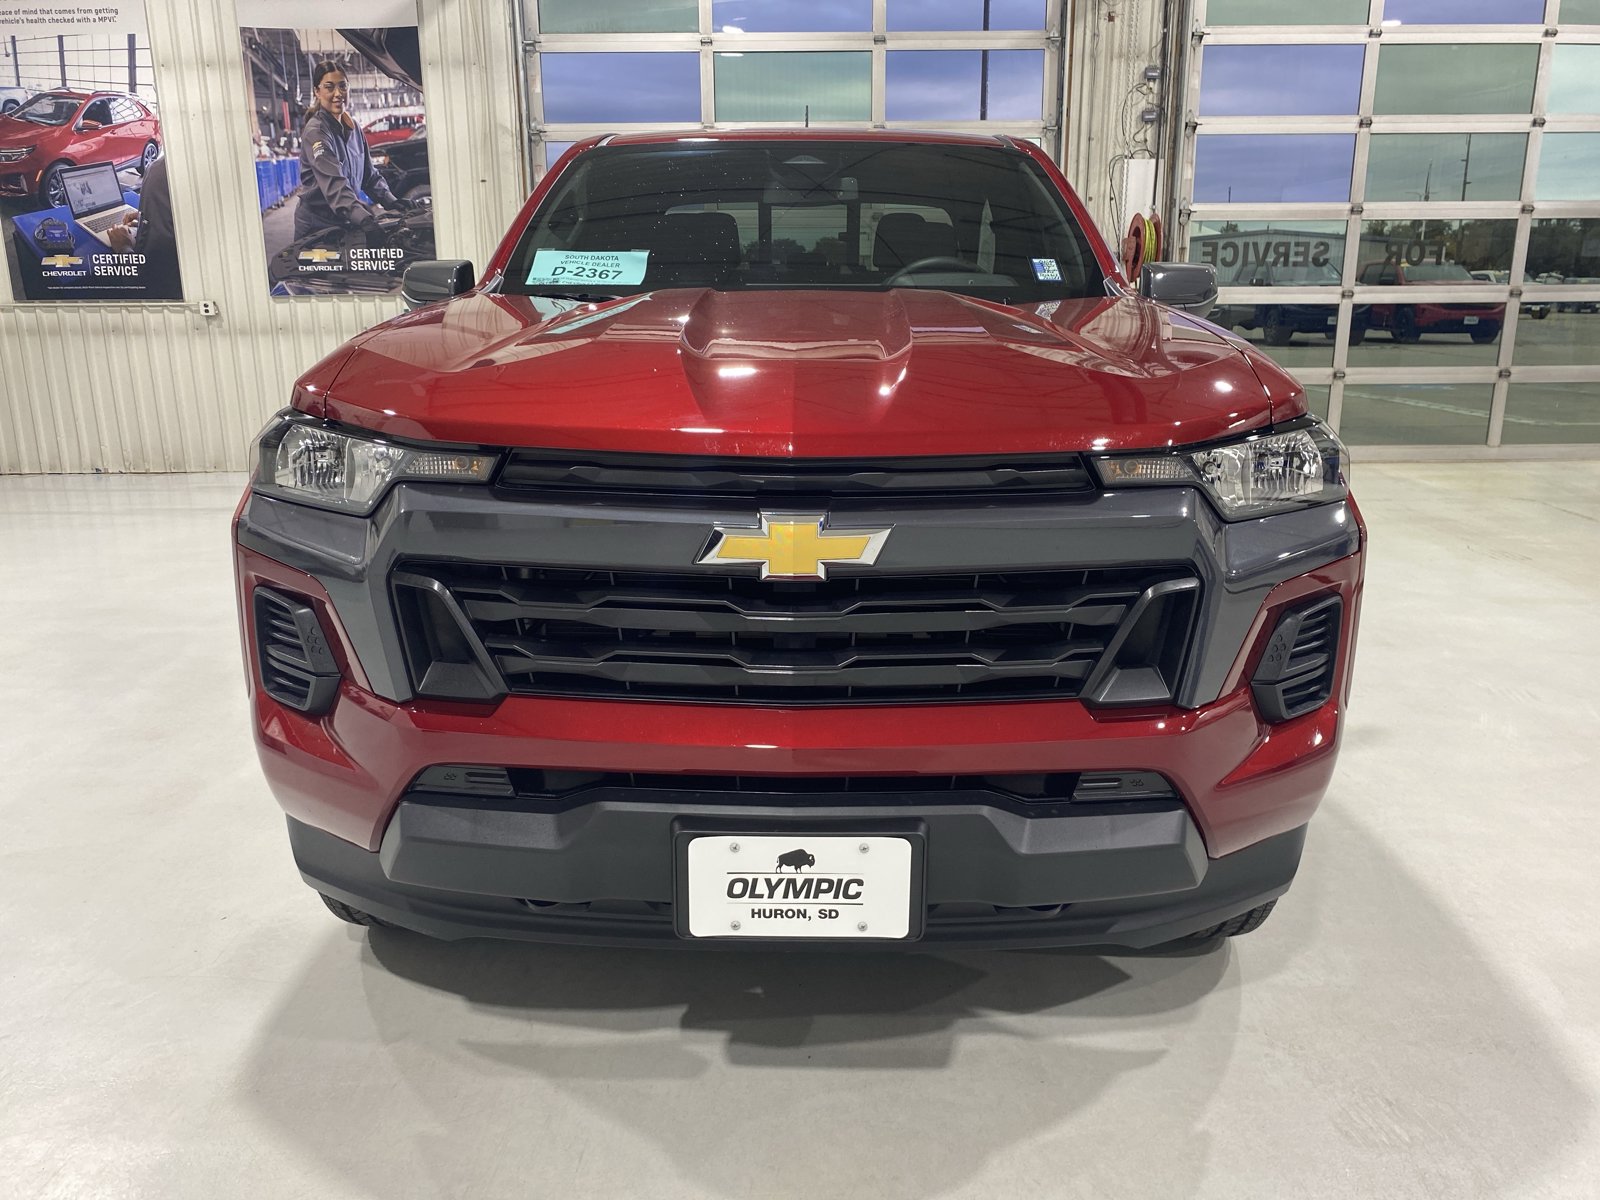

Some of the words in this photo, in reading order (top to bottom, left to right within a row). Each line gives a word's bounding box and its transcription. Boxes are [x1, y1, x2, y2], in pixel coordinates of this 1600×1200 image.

[95, 7, 119, 16] getting
[349, 248, 404, 259] CERTIFIED
[92, 254, 146, 265] CERTIFIED
[94, 265, 139, 276] SERVICE
[350, 260, 396, 271] SERVICE
[551, 266, 623, 280] D-2367
[726, 877, 865, 900] OLYMPIC
[751, 908, 812, 921] HURON,
[818, 908, 840, 919] SD
